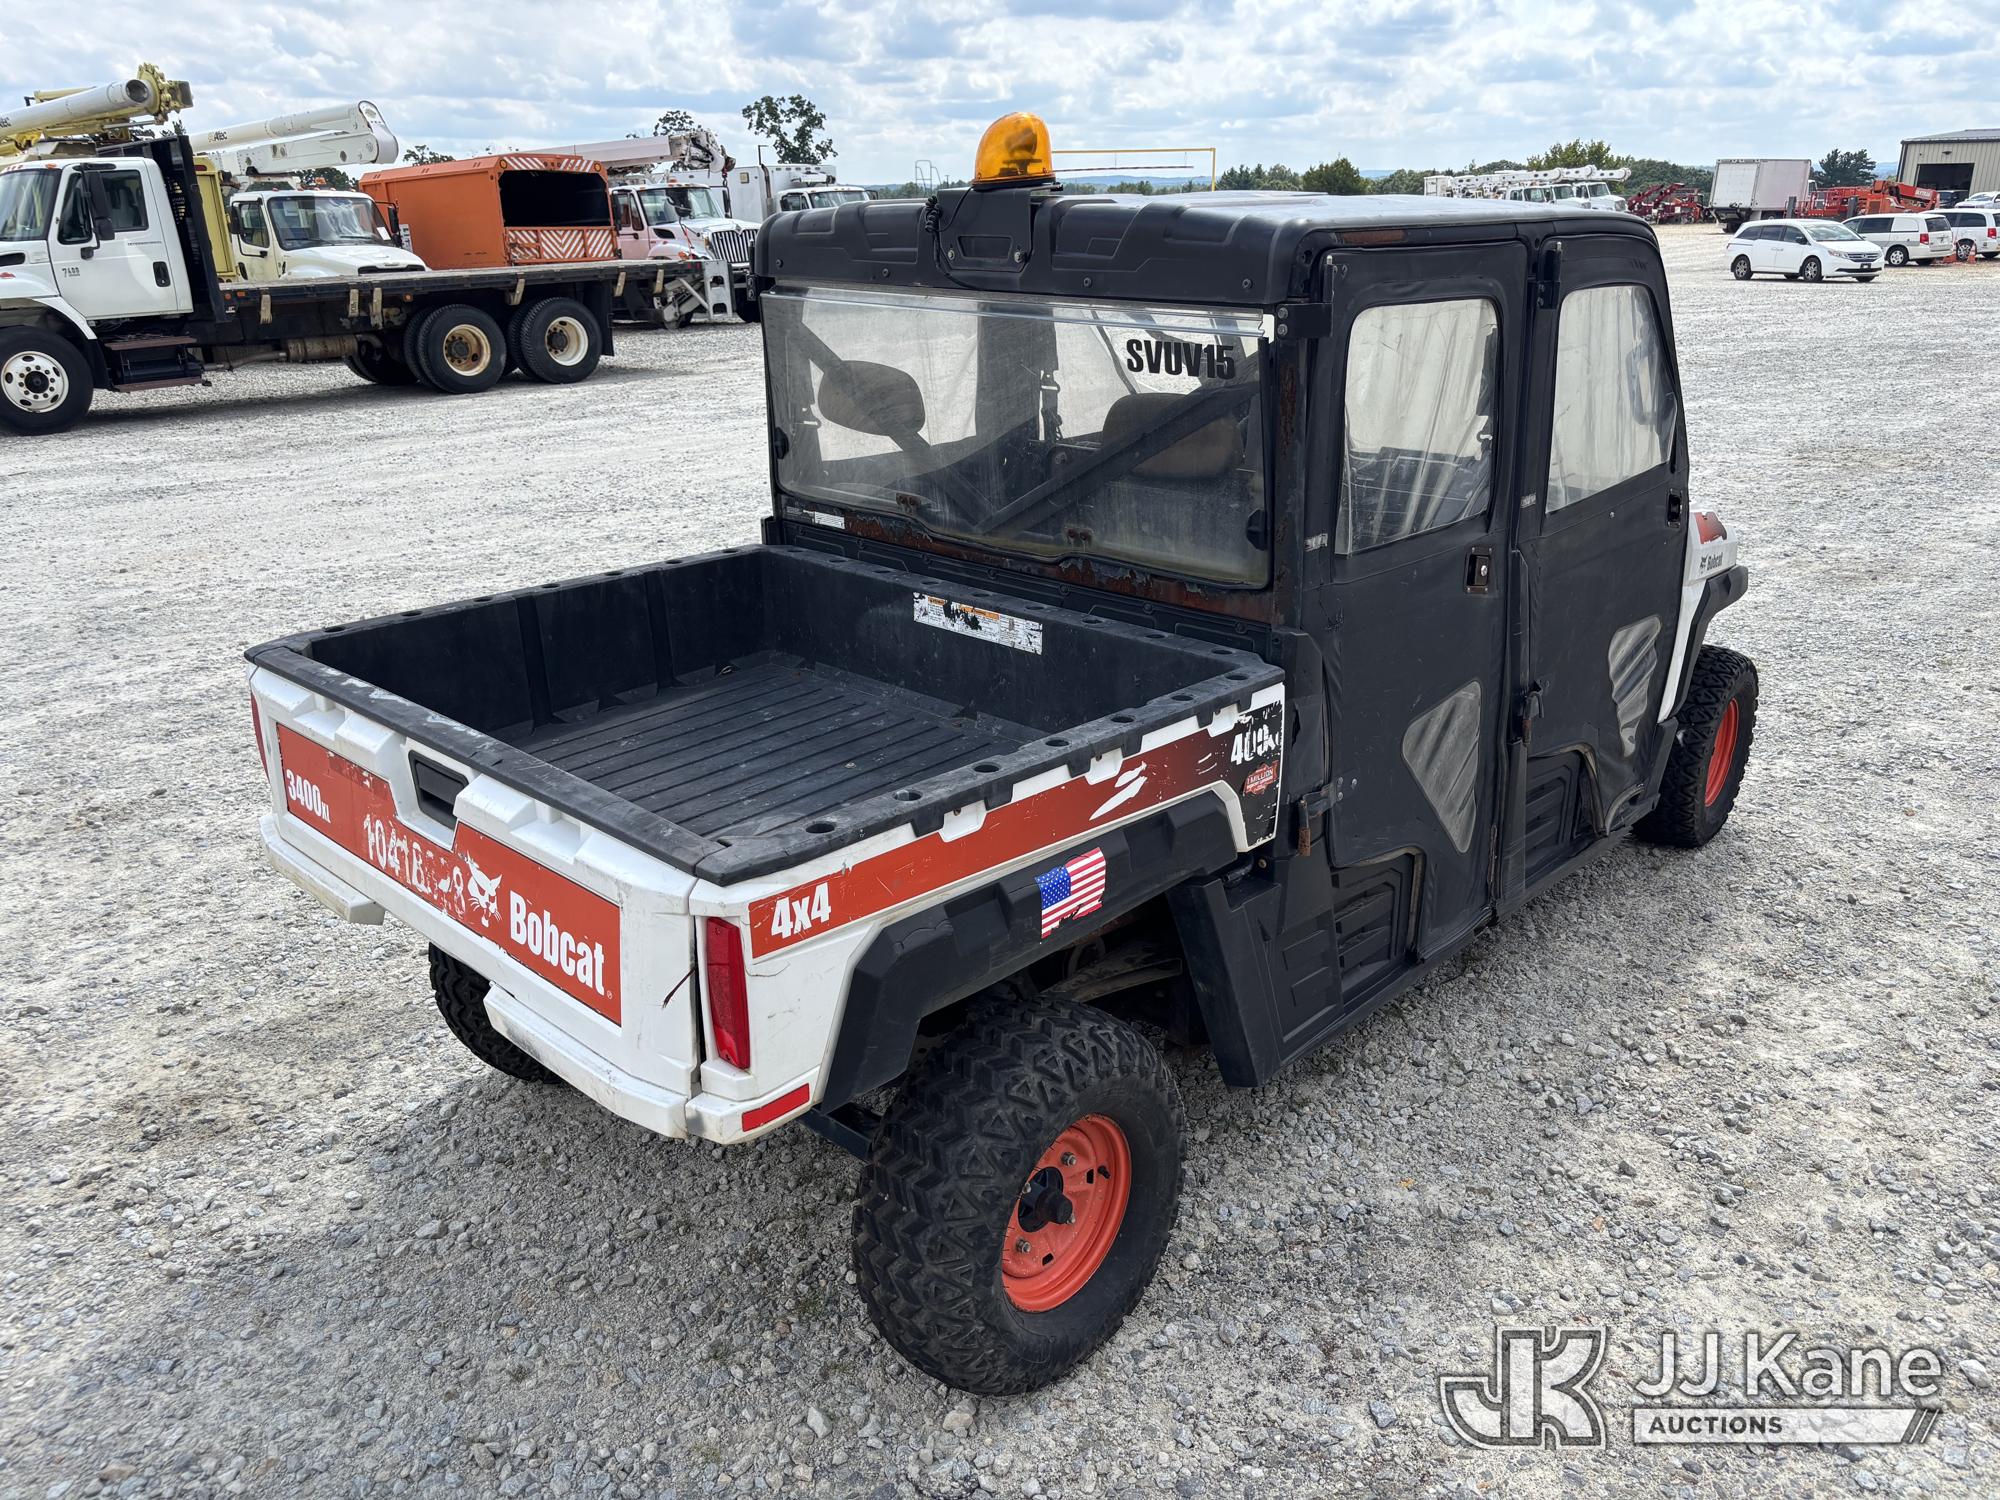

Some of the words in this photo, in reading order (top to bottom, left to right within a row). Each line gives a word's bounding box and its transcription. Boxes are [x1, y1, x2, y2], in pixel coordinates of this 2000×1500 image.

[1126, 338, 1236, 380] SVUV15
[771, 881, 832, 939] 4x4
[509, 889, 606, 997] Bobcat
